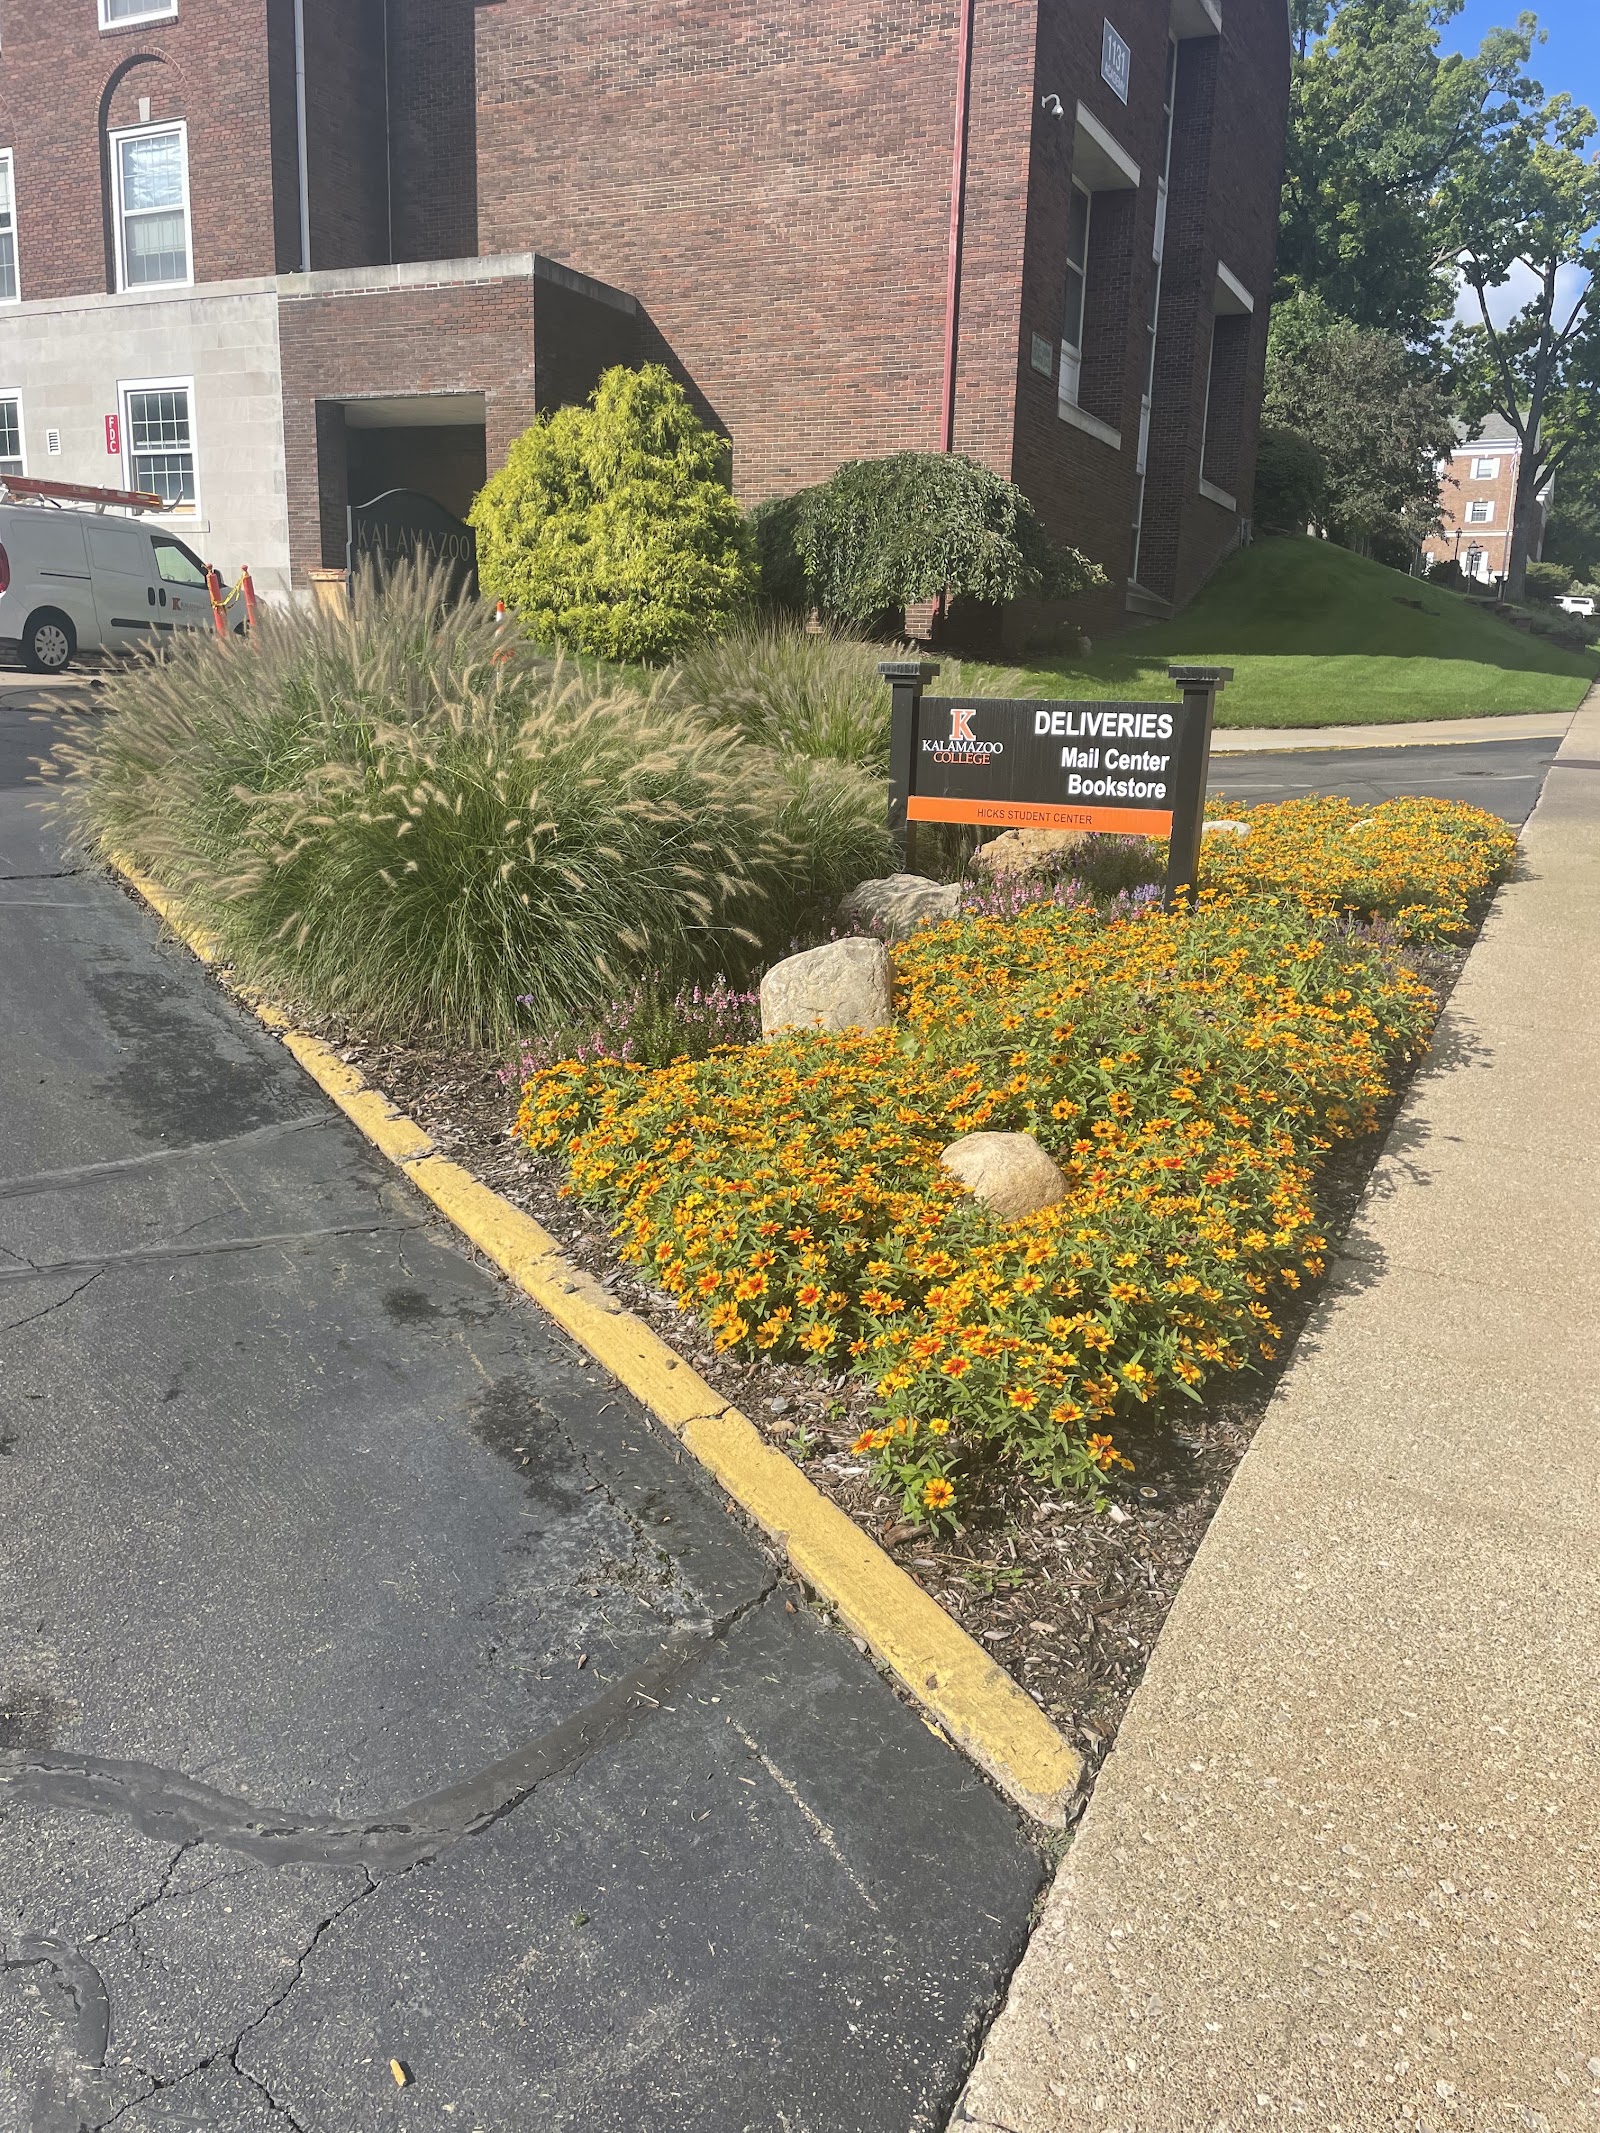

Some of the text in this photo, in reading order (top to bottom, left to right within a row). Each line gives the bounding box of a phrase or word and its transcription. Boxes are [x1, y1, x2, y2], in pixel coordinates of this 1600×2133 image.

[1108, 35, 1126, 77] 1131
[109, 416, 117, 453] FDC
[357, 519, 470, 561] KALAMAZOO
[949, 708, 977, 741] K
[1034, 711, 1174, 739] DELIVERIES
[922, 740, 1004, 754] KALAMAZOO
[933, 751, 991, 765] COLLEGE
[1061, 746, 1170, 772] Mail Center
[1067, 773, 1167, 799] Bookstore
[977, 808, 1093, 825] HICKS STUDENT CENTER
